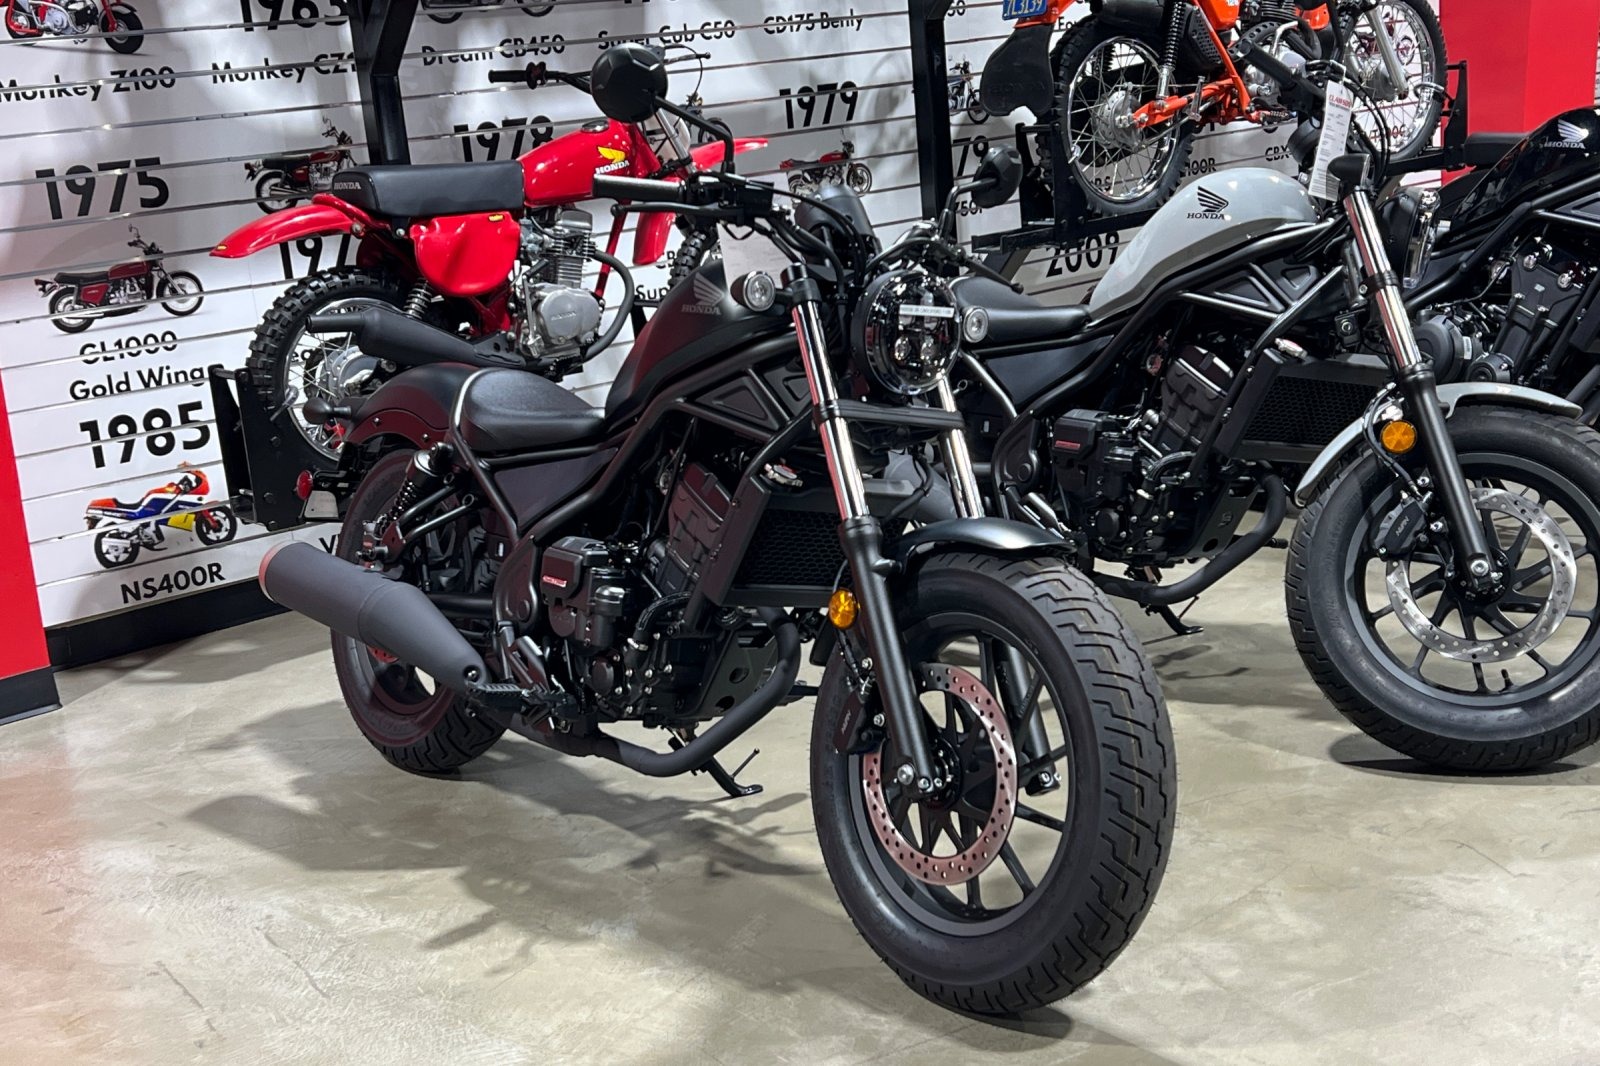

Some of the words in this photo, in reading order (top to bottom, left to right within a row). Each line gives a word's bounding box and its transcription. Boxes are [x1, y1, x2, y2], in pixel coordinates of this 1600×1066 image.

[659, 22, 695, 44] Cub
[700, 20, 735, 41] C50
[763, 13, 815, 35] CD175
[820, 8, 863, 32] Benly
[421, 45, 494, 66] Dream
[499, 34, 566, 59] CB450
[0, 74, 103, 102] Monkey
[110, 66, 177, 93] Z100
[211, 57, 307, 84] Monkey
[779, 81, 859, 130] 1979
[453, 114, 554, 163] 1978
[1544, 140, 1586, 150] HONDA
[594, 159, 630, 174] HONDA
[35, 156, 170, 221] 1975
[333, 181, 362, 191] HONDA
[1187, 212, 1225, 221] HONDA
[1046, 231, 1120, 278] 2009
[681, 303, 722, 316] HONDA
[79, 329, 178, 365] GL1000
[69, 371, 132, 402] Gold
[136, 364, 206, 390] Wing
[79, 400, 211, 469] 1985
[120, 561, 226, 605] NS400R
